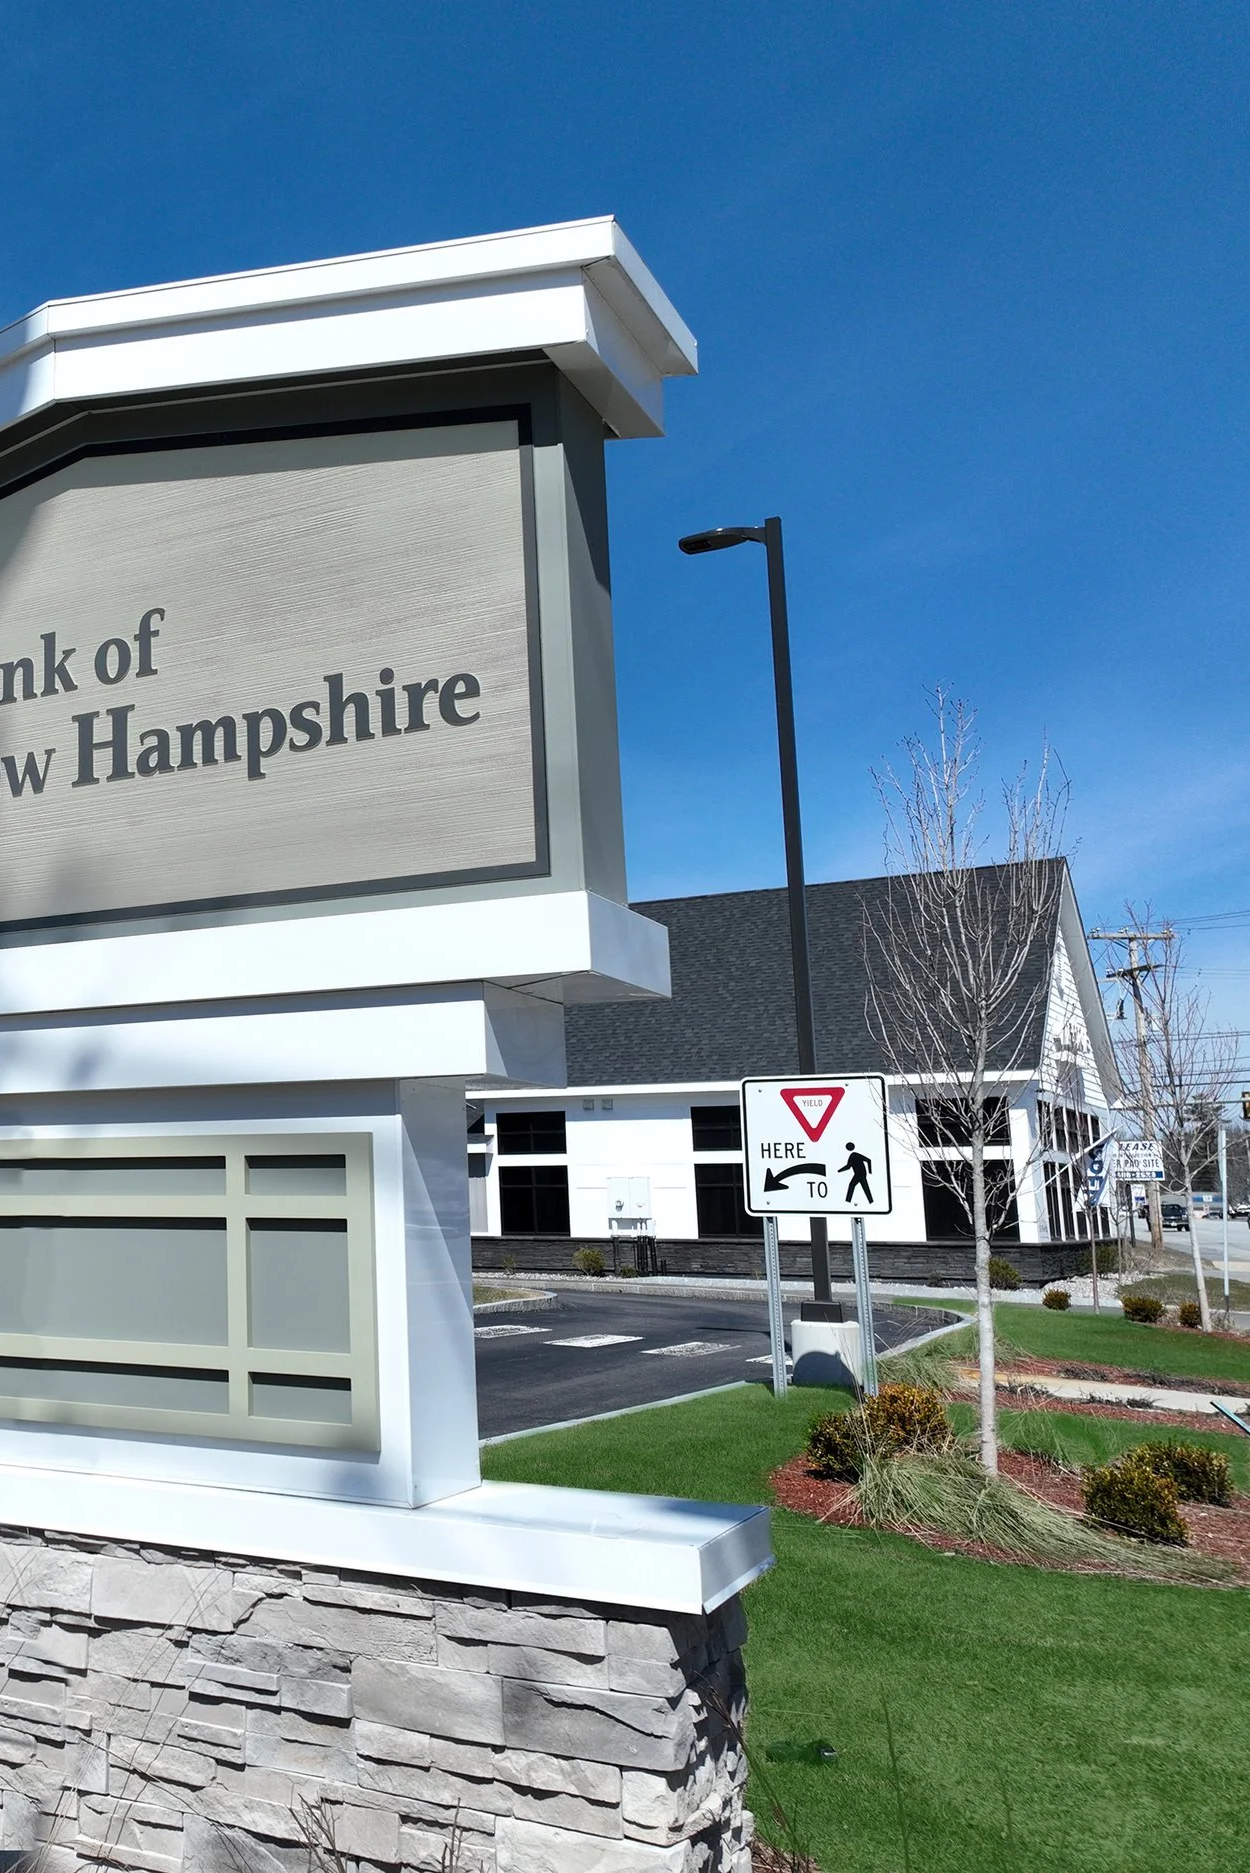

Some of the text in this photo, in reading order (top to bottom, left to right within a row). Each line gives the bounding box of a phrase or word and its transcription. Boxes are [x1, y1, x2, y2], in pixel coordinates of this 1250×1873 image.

[94, 607, 166, 686] of
[71, 667, 481, 788] Hampshire
[802, 1099, 823, 1107] YIELD
[760, 1142, 806, 1159] HERE
[1142, 1159, 1160, 1168] SITE
[807, 1181, 828, 1199] TO
